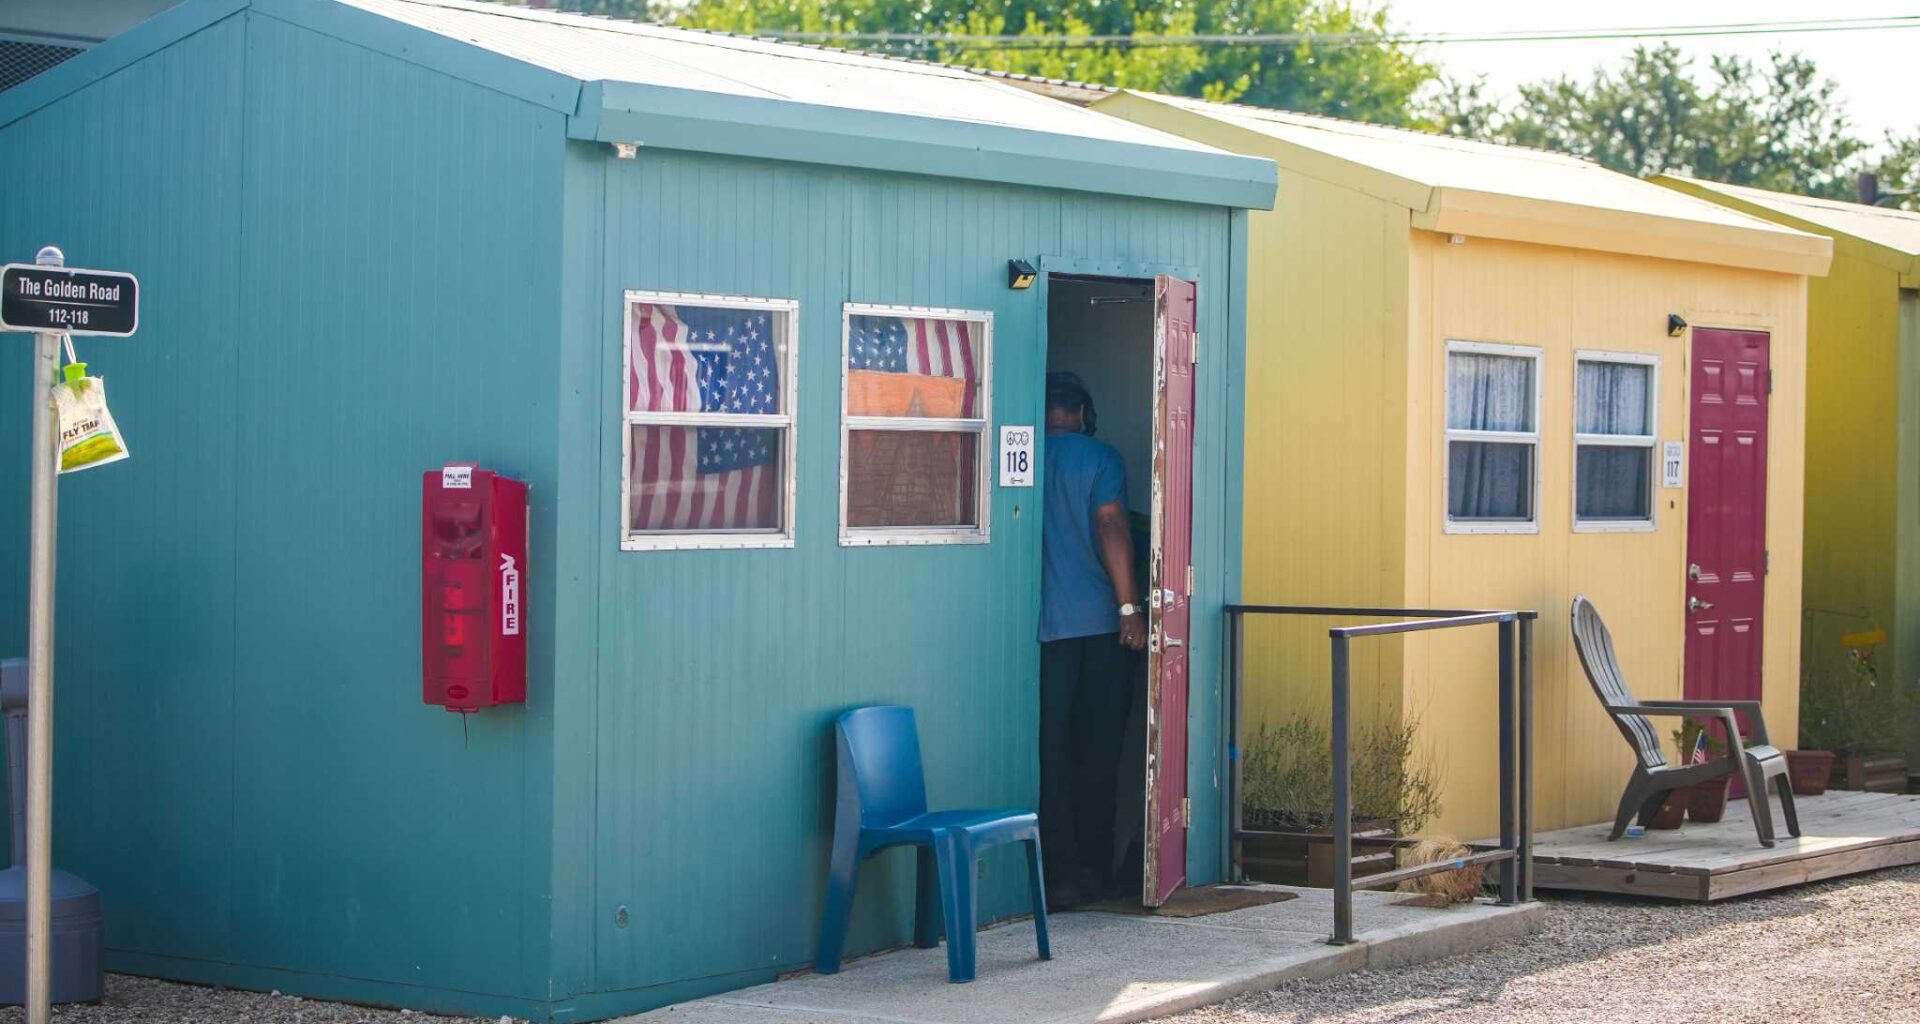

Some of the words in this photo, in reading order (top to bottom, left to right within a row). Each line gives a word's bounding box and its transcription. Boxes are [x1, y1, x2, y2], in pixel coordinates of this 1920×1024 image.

[18, 277, 41, 295] The
[44, 279, 86, 299] Golden
[89, 282, 120, 301] Road
[49, 308, 89, 325] 112-118
[63, 427, 79, 440] FLY
[1006, 450, 1028, 473] 118
[1667, 460, 1680, 477] 117
[506, 574, 516, 629] FIRE
